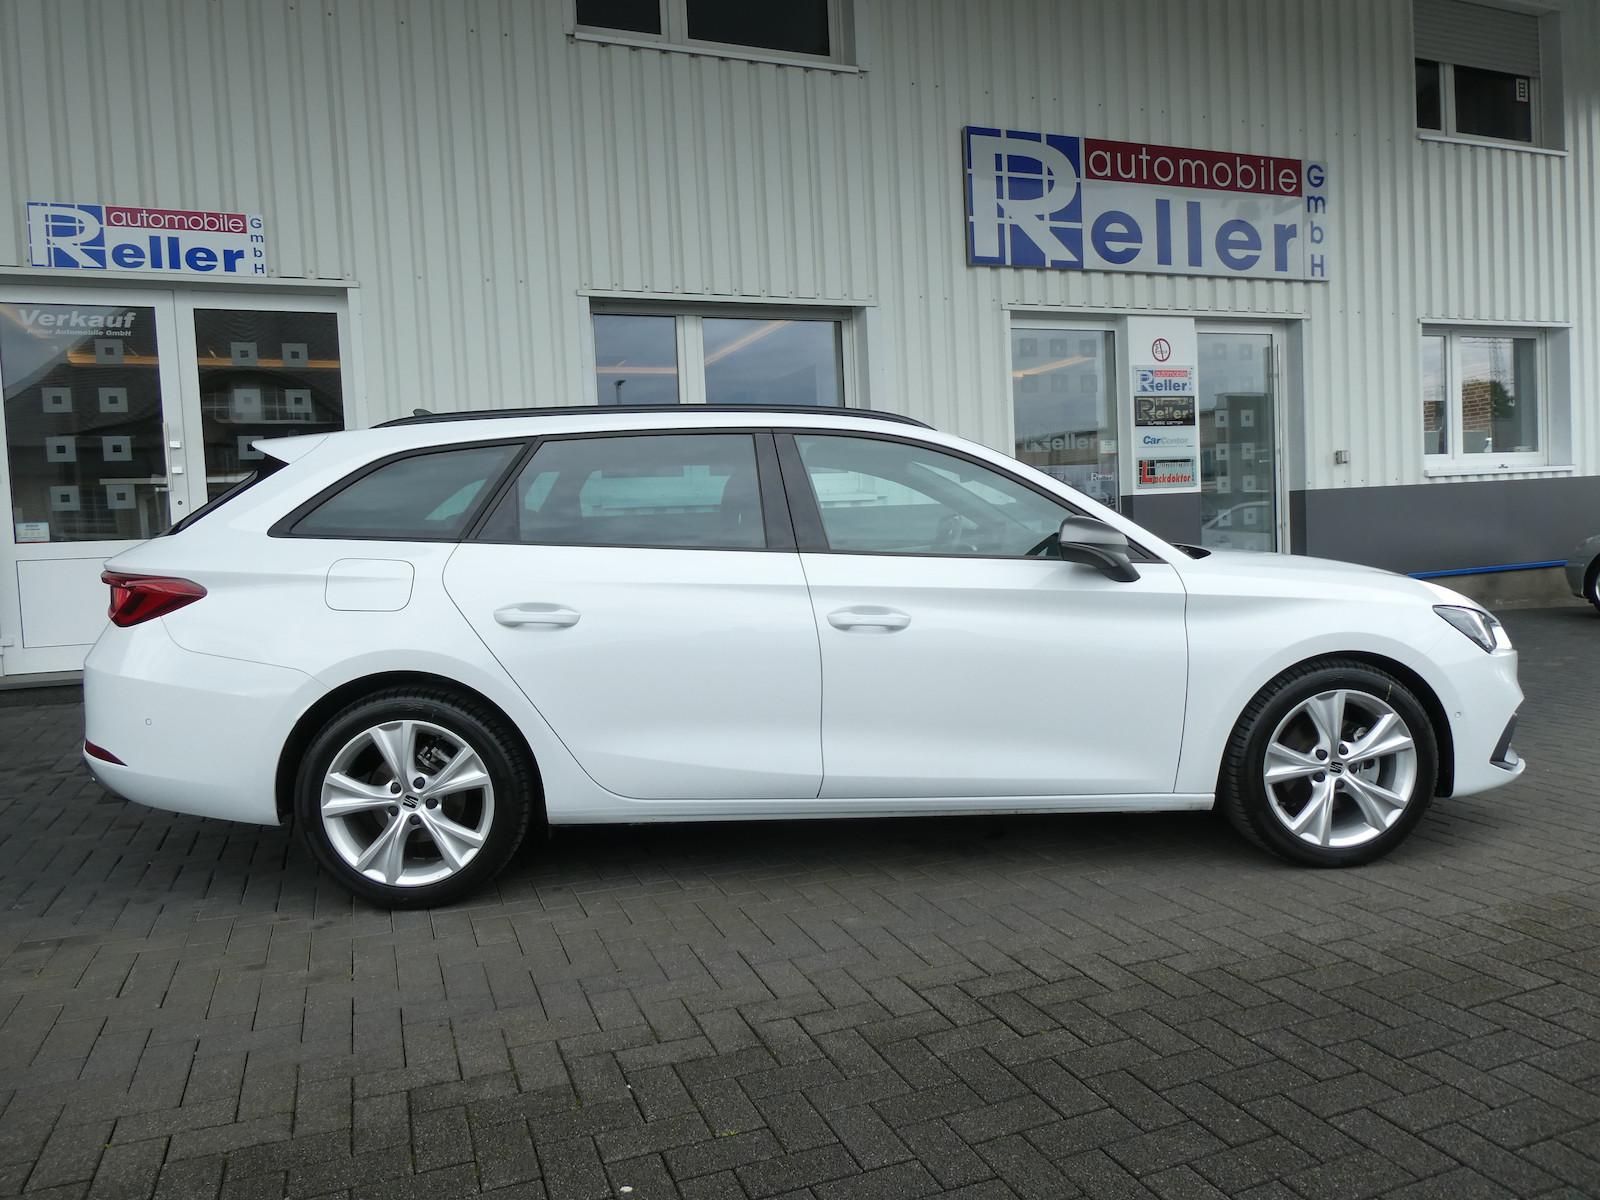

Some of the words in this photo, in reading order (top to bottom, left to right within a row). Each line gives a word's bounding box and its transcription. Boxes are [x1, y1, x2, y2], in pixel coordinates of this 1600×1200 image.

[1089, 147, 1297, 193] automobile
[110, 210, 244, 233] automobile
[969, 134, 1297, 273] Reller
[1306, 164, 1326, 277] GmbH
[28, 203, 245, 272] Reller
[250, 217, 265, 274] GmbH
[19, 309, 136, 328] Verkauf
[106, 329, 131, 337] GmbH
[1136, 370, 1188, 392] Reller
